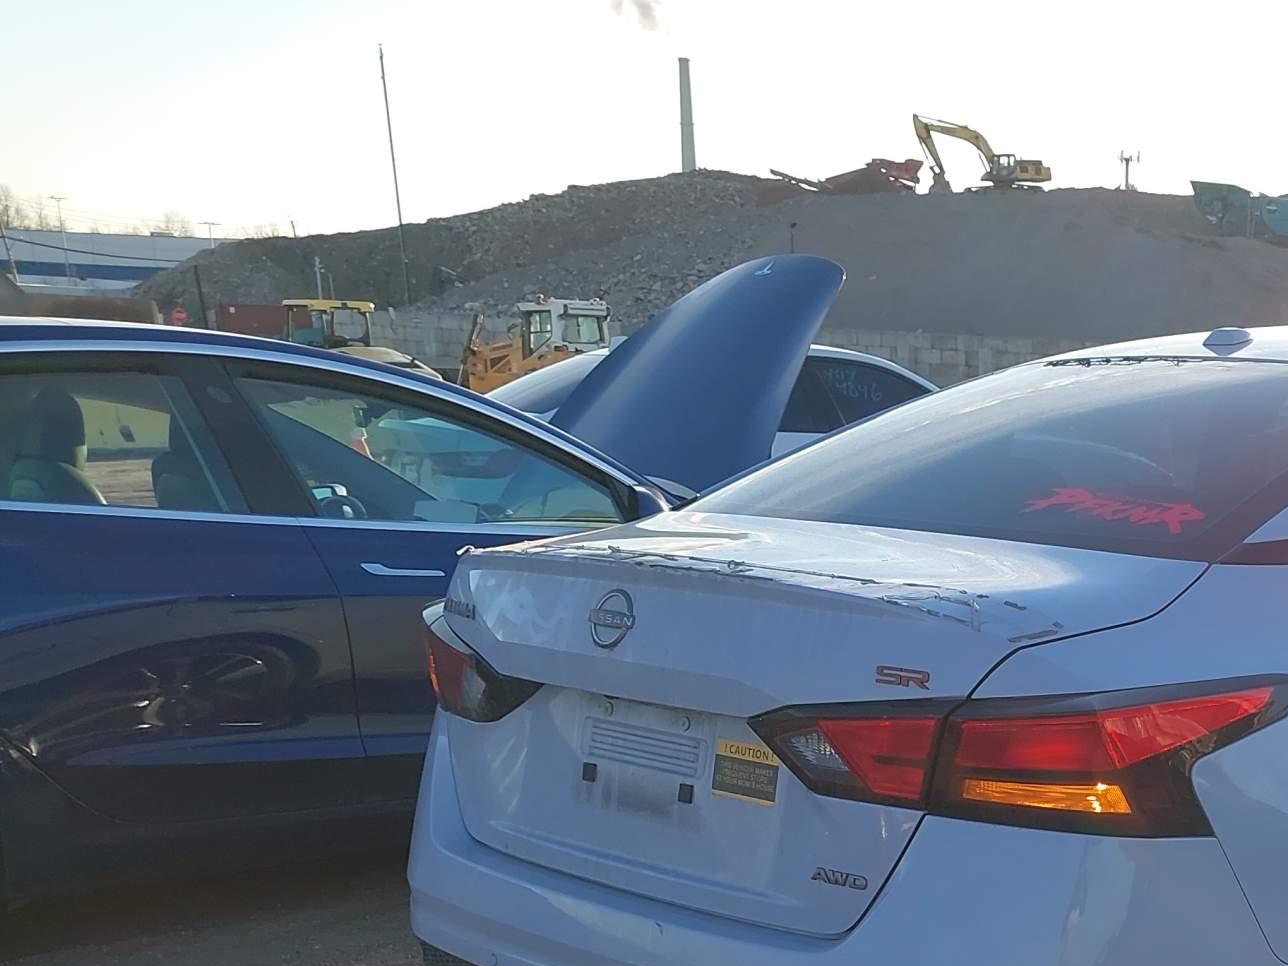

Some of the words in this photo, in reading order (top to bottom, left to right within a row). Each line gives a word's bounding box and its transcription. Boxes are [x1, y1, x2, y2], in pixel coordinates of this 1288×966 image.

[876, 665, 930, 690] SR
[729, 744, 769, 760] CAUTION
[811, 867, 868, 890] AWD
